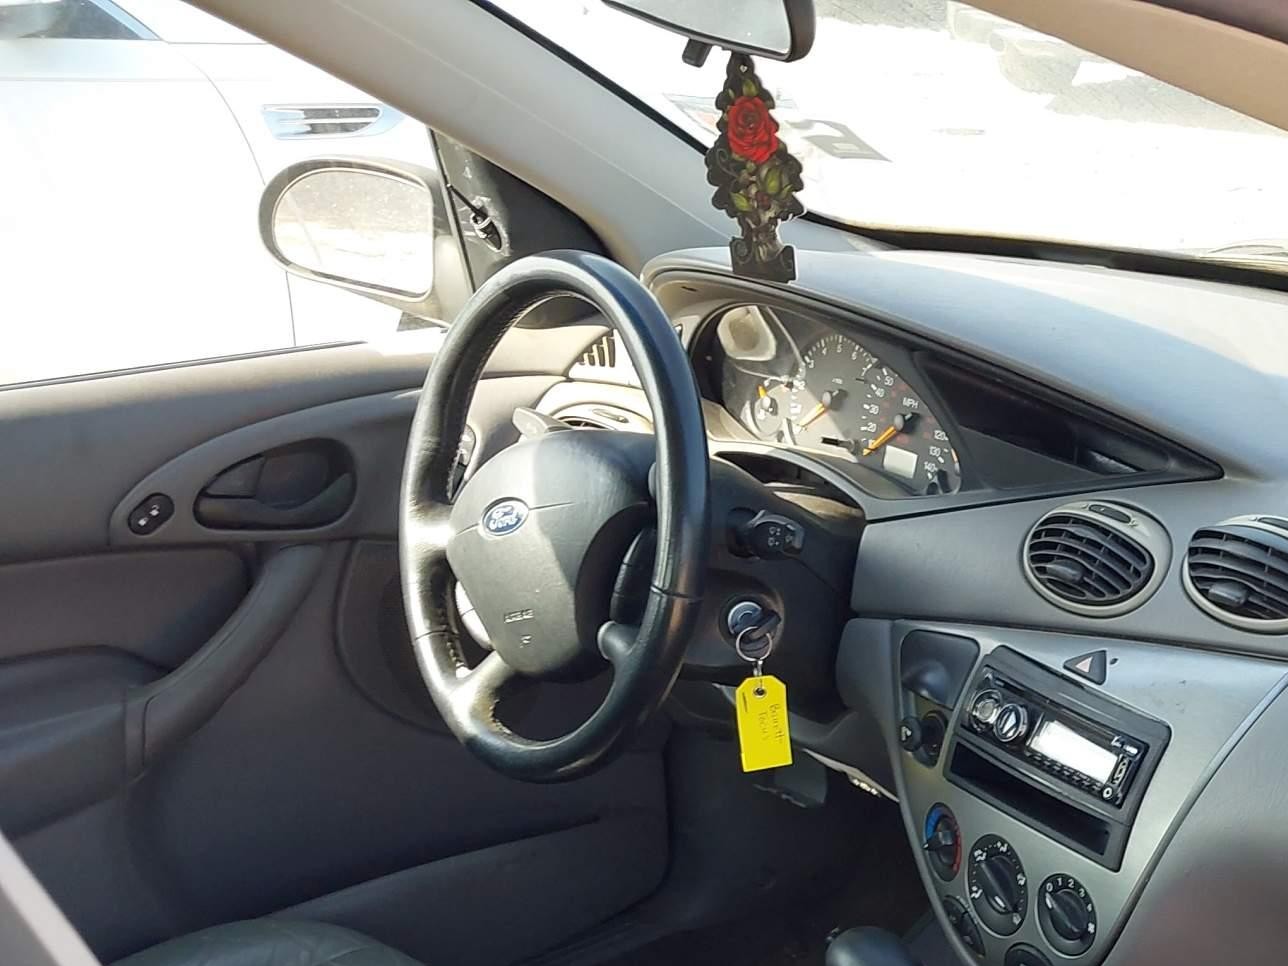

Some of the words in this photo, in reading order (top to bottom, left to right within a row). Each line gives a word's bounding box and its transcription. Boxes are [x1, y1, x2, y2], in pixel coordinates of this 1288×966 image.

[884, 376, 894, 386] 50
[875, 388, 885, 398] 40
[902, 397, 919, 409] MPH
[868, 404, 879, 414] 30
[866, 422, 877, 433] 20
[934, 430, 946, 441] 120
[929, 446, 941, 457] 130
[1046, 882, 1053, 892] 0
[1067, 878, 1075, 889] 2
[1078, 888, 1086, 898] 3
